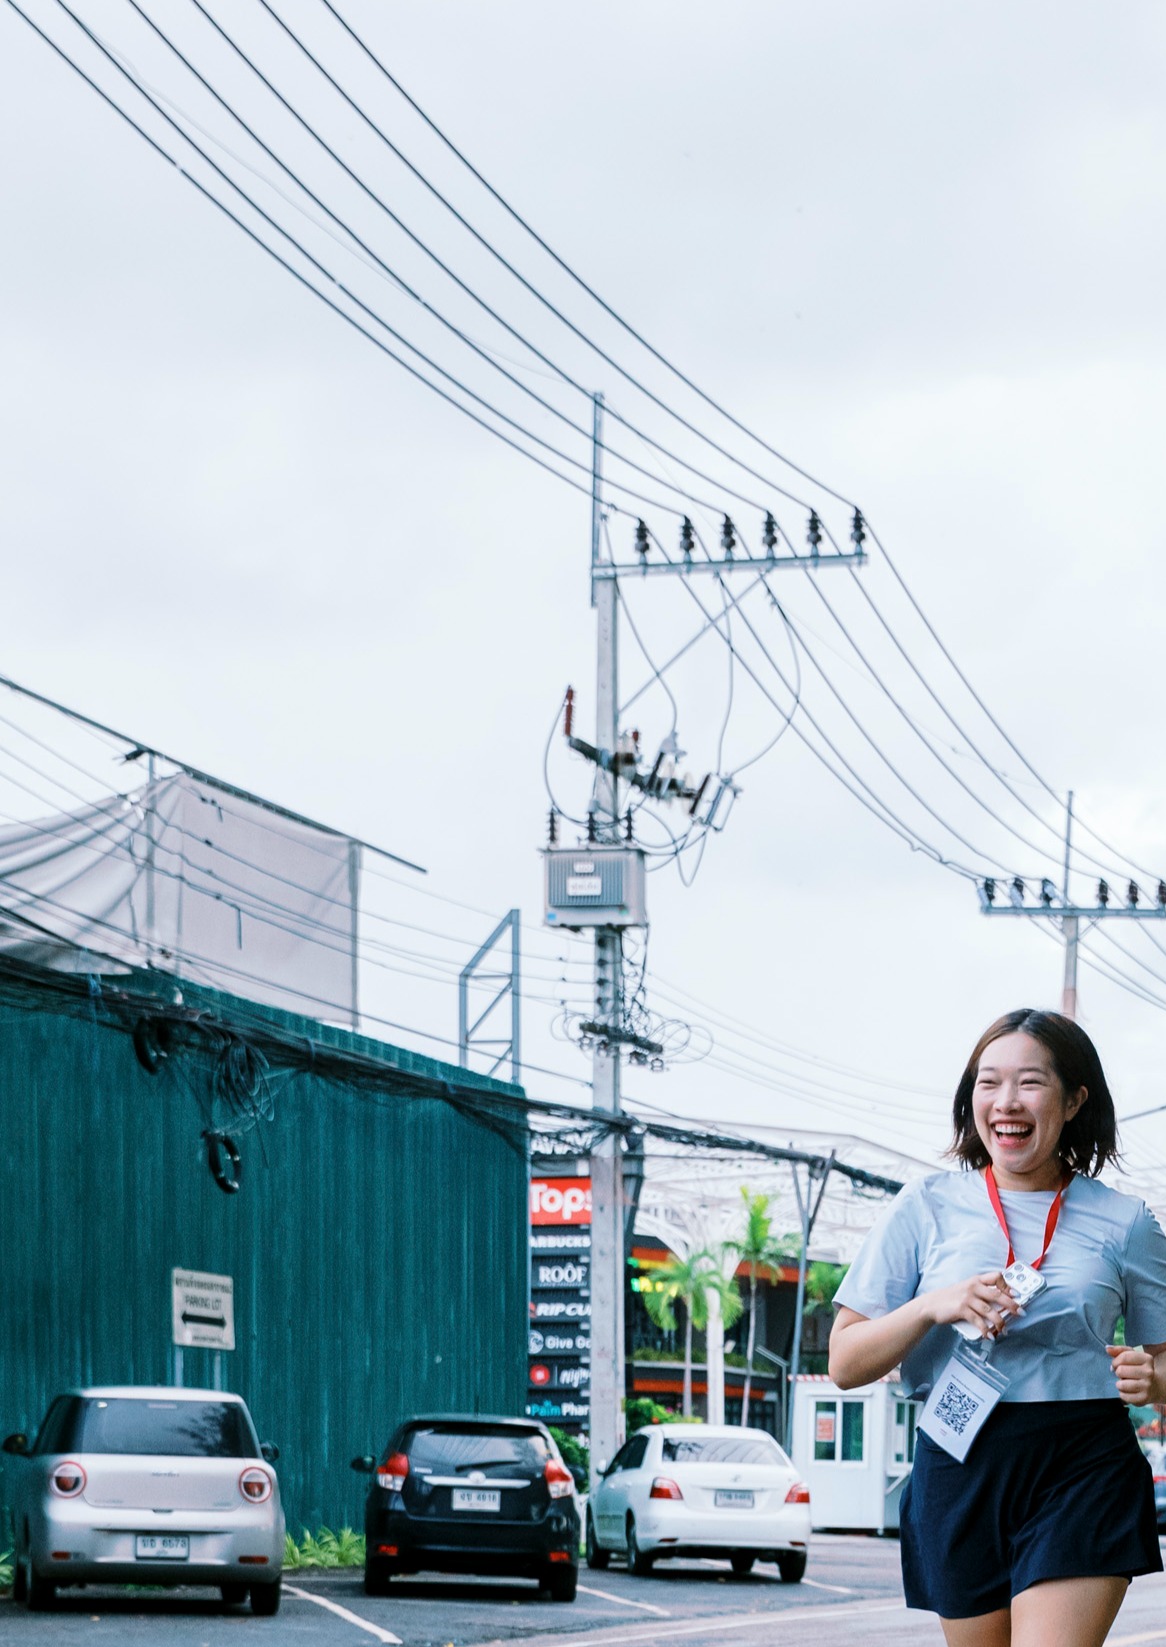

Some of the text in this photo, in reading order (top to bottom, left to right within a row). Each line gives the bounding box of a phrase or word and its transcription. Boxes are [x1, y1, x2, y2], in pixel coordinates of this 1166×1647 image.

[184, 1294, 222, 1311] PARKING LOT
[545, 1334, 574, 1350] Give
[531, 1400, 561, 1416] Palm
